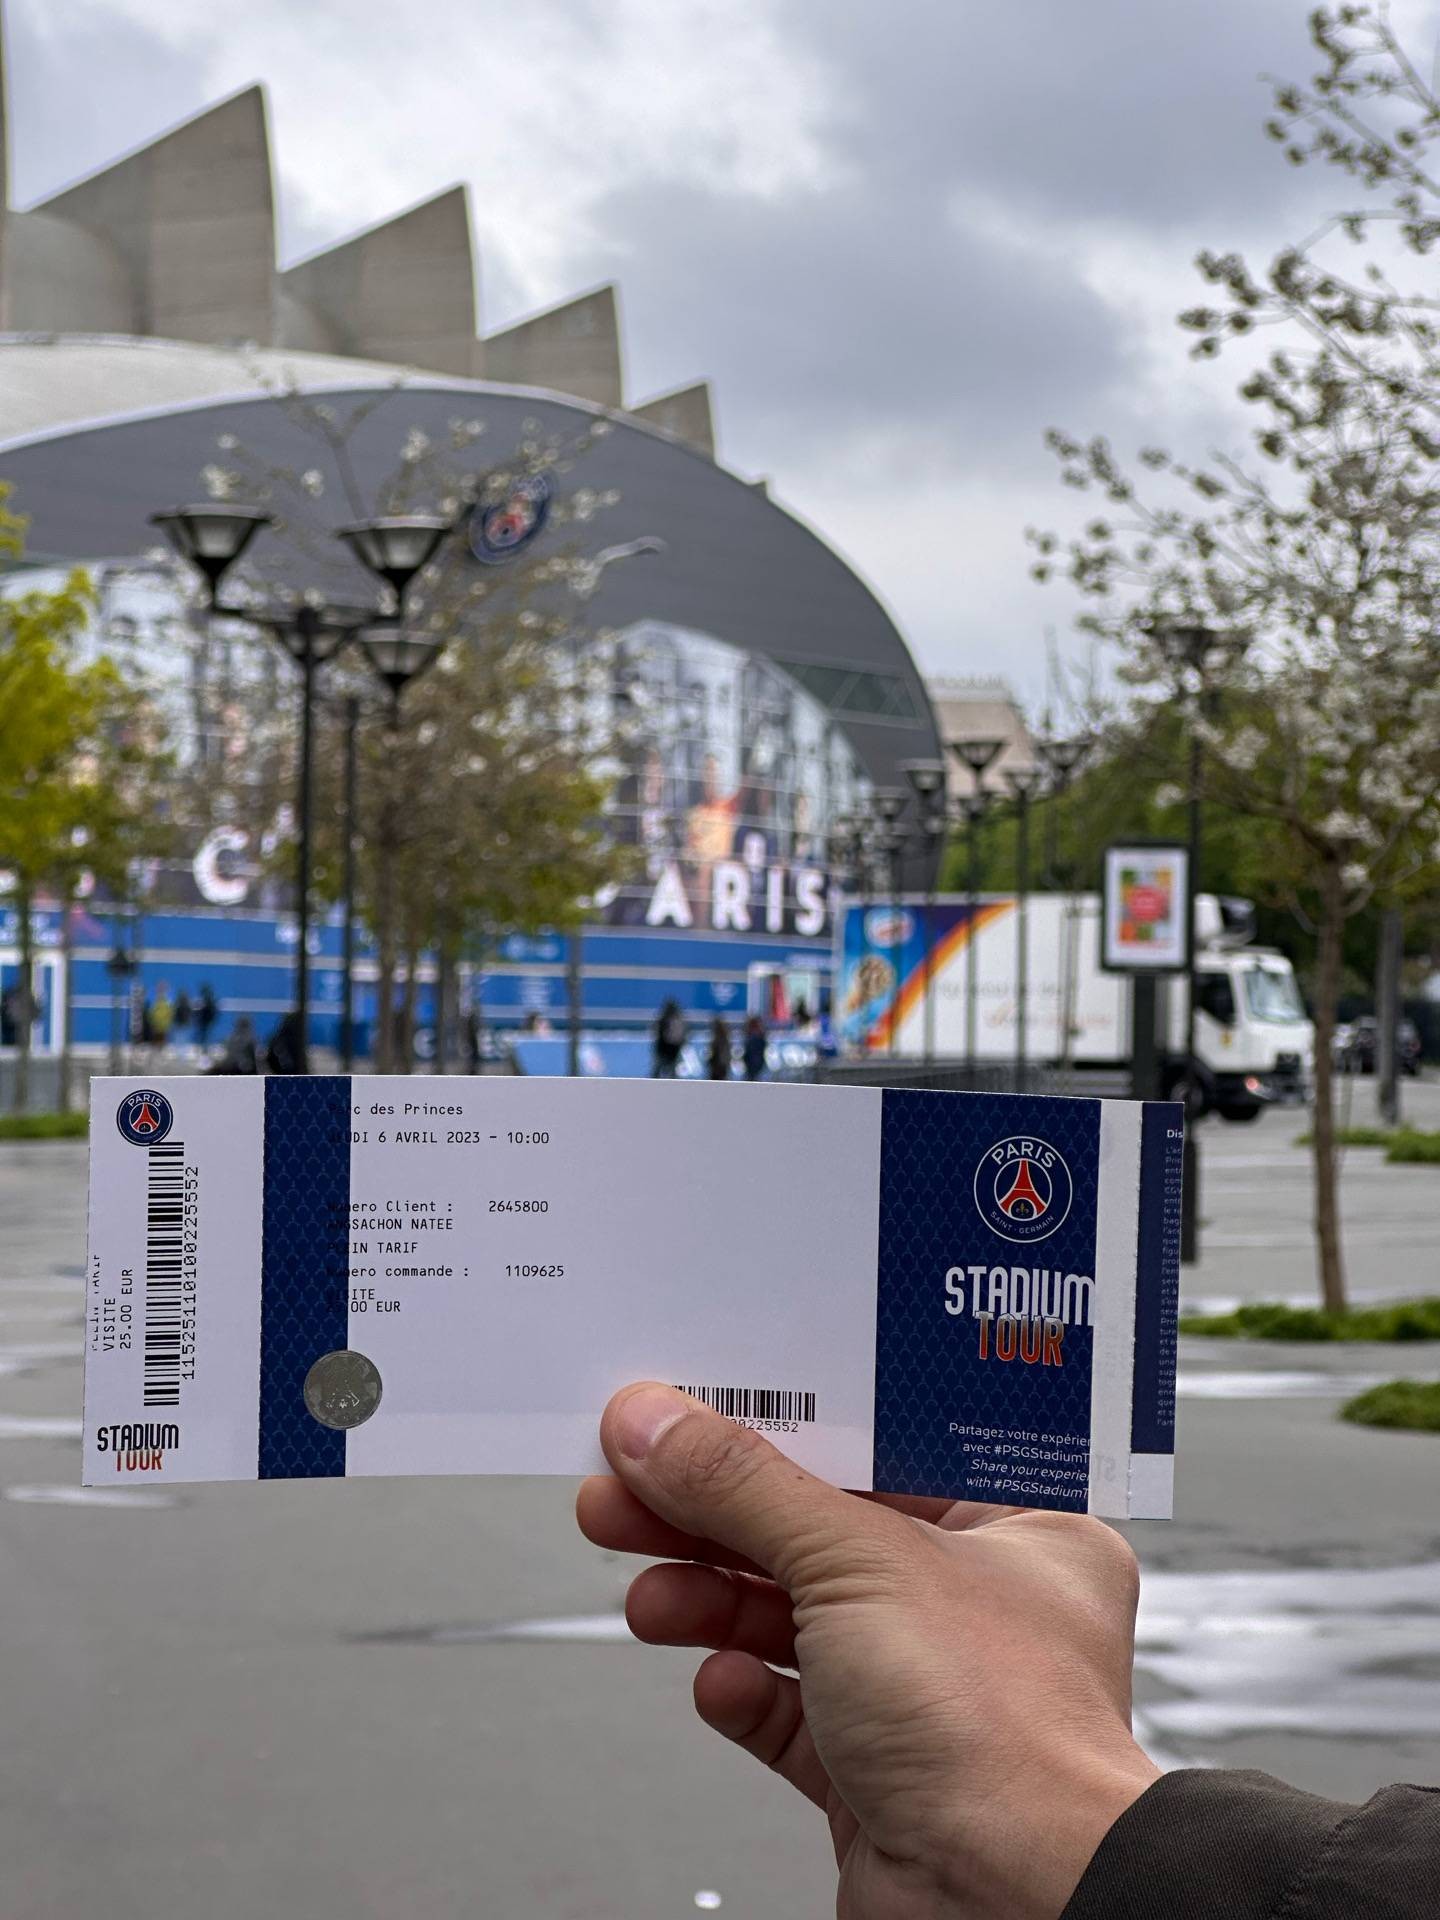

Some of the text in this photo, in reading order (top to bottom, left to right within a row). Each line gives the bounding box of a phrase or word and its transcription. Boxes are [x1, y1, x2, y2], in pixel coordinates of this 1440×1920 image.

[598, 859, 827, 938] ARIS
[128, 1094, 162, 1107] PARIS
[370, 1103, 395, 1115] des
[404, 1103, 464, 1115] Princes
[378, 1131, 387, 1143] 6
[395, 1131, 438, 1143] AVRIL
[447, 1132, 480, 1143] 2023
[507, 1132, 550, 1144] 10:00
[991, 1141, 1056, 1168] PARIS
[386, 1200, 436, 1212] Client
[488, 1200, 549, 1212] 2645800
[410, 1218, 454, 1230] NATEE
[376, 1242, 419, 1254] TARIF
[182, 1166, 198, 1380] 11525110100225552
[385, 1265, 453, 1277] commande
[504, 1265, 564, 1277] 1109625
[376, 1301, 401, 1312] EUR
[944, 1265, 1096, 1327] STADIUM
[120, 1269, 133, 1350] 25.00 EUR
[103, 1297, 116, 1351] VISITE
[974, 1310, 1065, 1367] TOUR
[97, 1423, 179, 1452] STADIUM
[949, 1422, 1005, 1440] Partagez
[1007, 1430, 1039, 1442] votre
[116, 1449, 163, 1472] TOUR
[962, 1443, 1090, 1464] avec #PSGStadiumT
[970, 1458, 1008, 1473] Share
[1010, 1464, 1039, 1477] your
[966, 1476, 1090, 1499] with #PSGStadiumT
